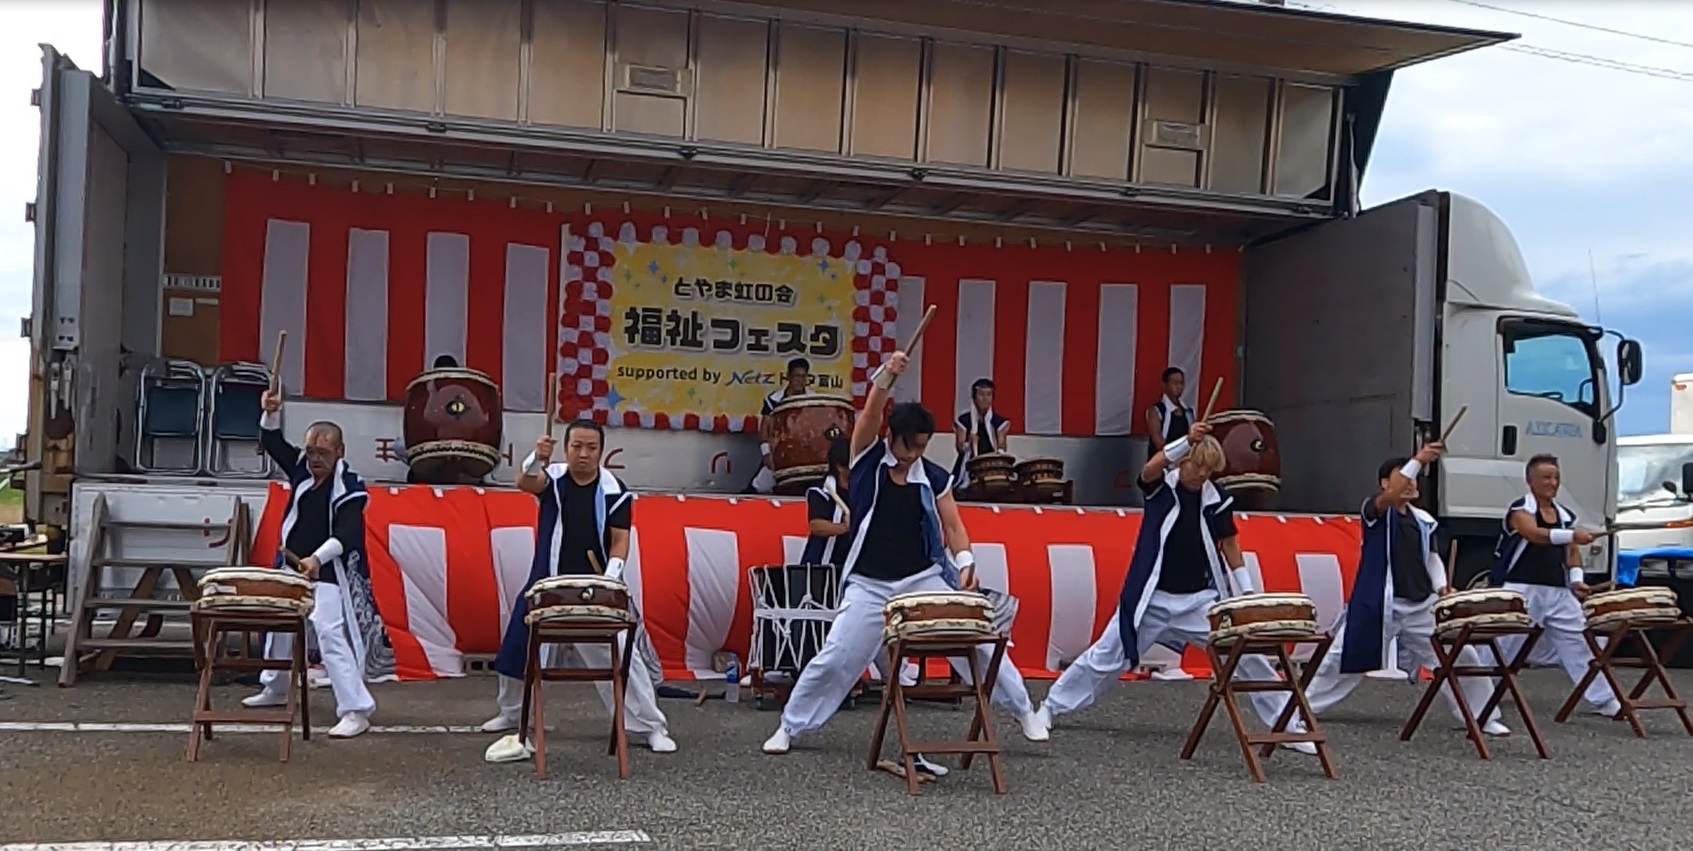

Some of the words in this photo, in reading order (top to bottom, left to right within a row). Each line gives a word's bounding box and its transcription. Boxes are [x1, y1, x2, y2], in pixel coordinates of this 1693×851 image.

[674, 277, 794, 303] とやま虹の会
[624, 307, 839, 356] 福祉フェスタ
[617, 366, 698, 381] supported
[703, 368, 721, 384] by
[779, 371, 843, 389] トタ富山
